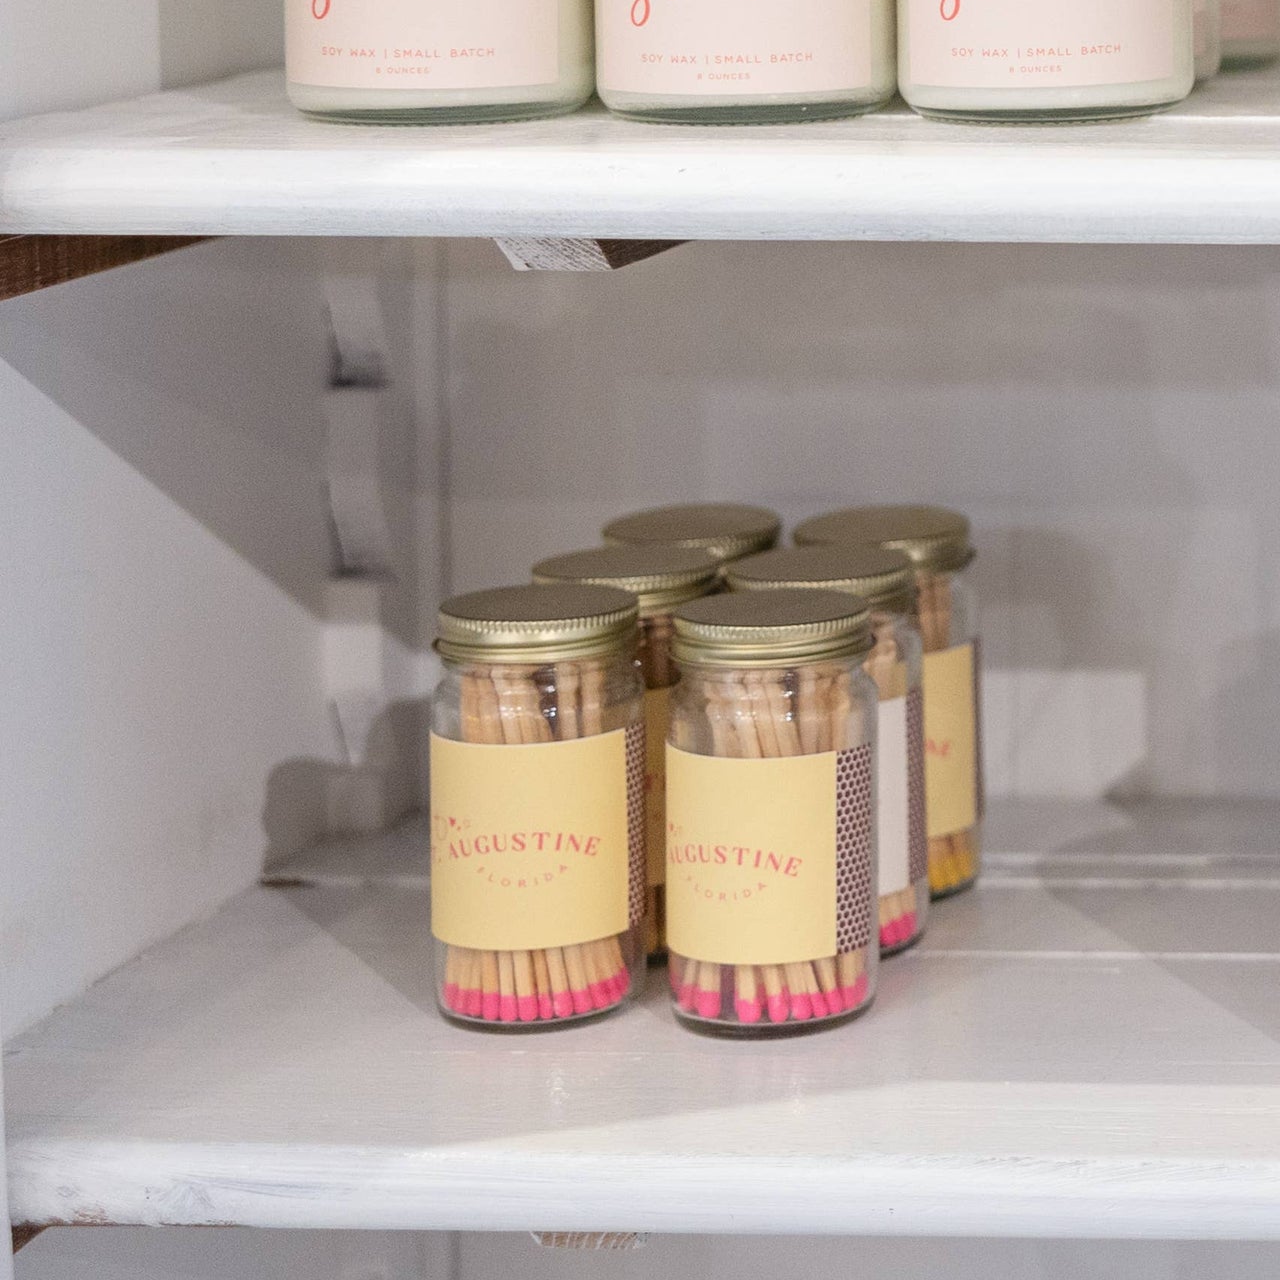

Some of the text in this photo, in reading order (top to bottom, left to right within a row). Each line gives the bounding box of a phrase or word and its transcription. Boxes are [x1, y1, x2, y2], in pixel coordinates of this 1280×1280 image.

[320, 45, 496, 59] SOY WAX SMALL BATCH
[951, 43, 1121, 58] SOY WAX SMALL BATCH
[640, 51, 814, 65] SOY WAX SMALL BATCH
[386, 66, 431, 75] OUNCES
[707, 72, 751, 80] OUNCES
[1020, 65, 1062, 74] OUNCES
[449, 831, 601, 859] AUGUSTINE
[668, 844, 803, 877] AUGUSTINE
